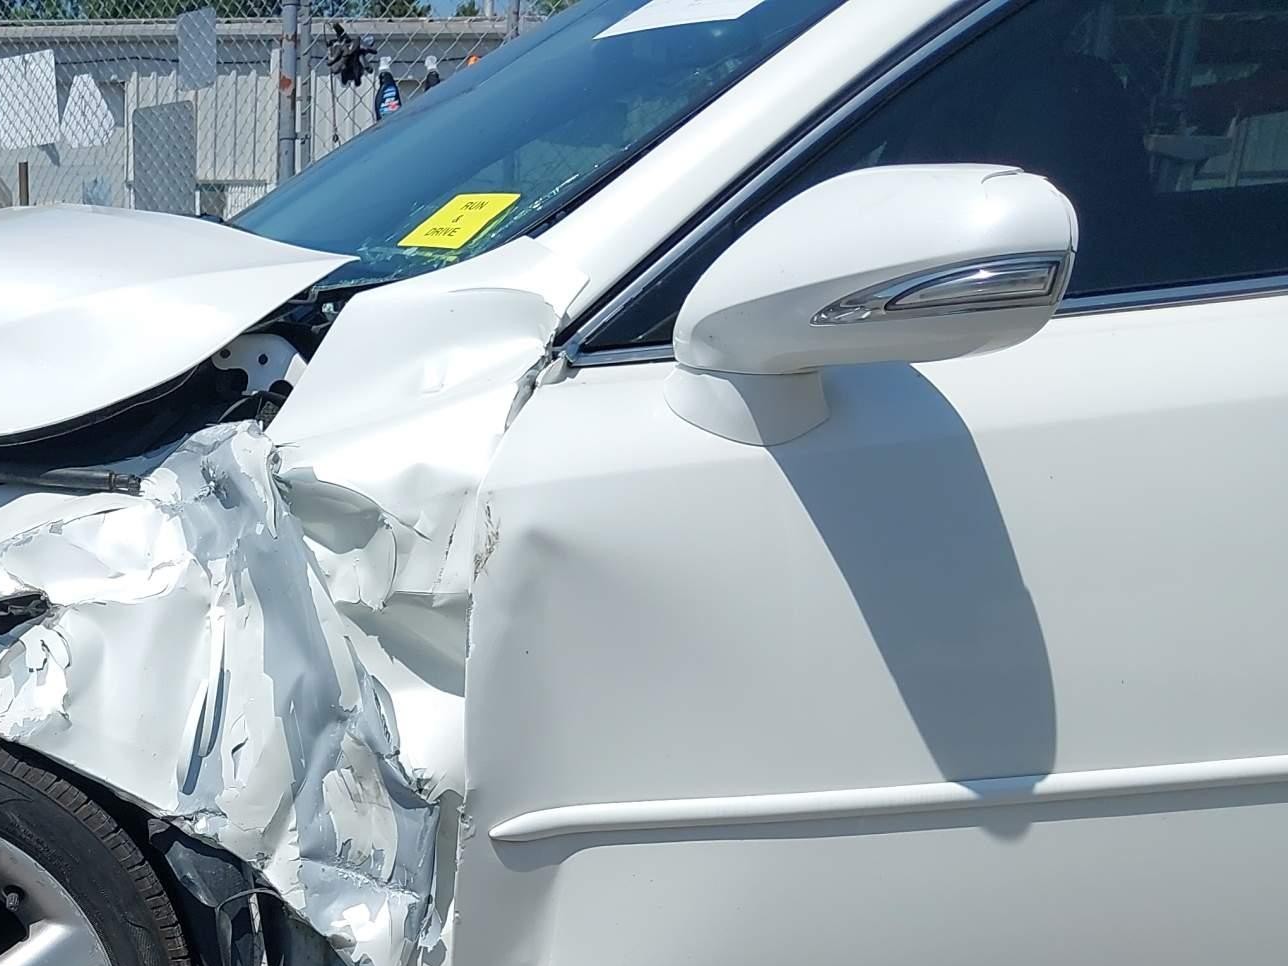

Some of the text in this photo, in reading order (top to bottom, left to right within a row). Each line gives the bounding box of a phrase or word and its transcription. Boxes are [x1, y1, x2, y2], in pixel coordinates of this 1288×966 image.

[460, 200, 489, 211] RUN
[451, 214, 464, 223] &
[423, 227, 462, 237] DRIVE
